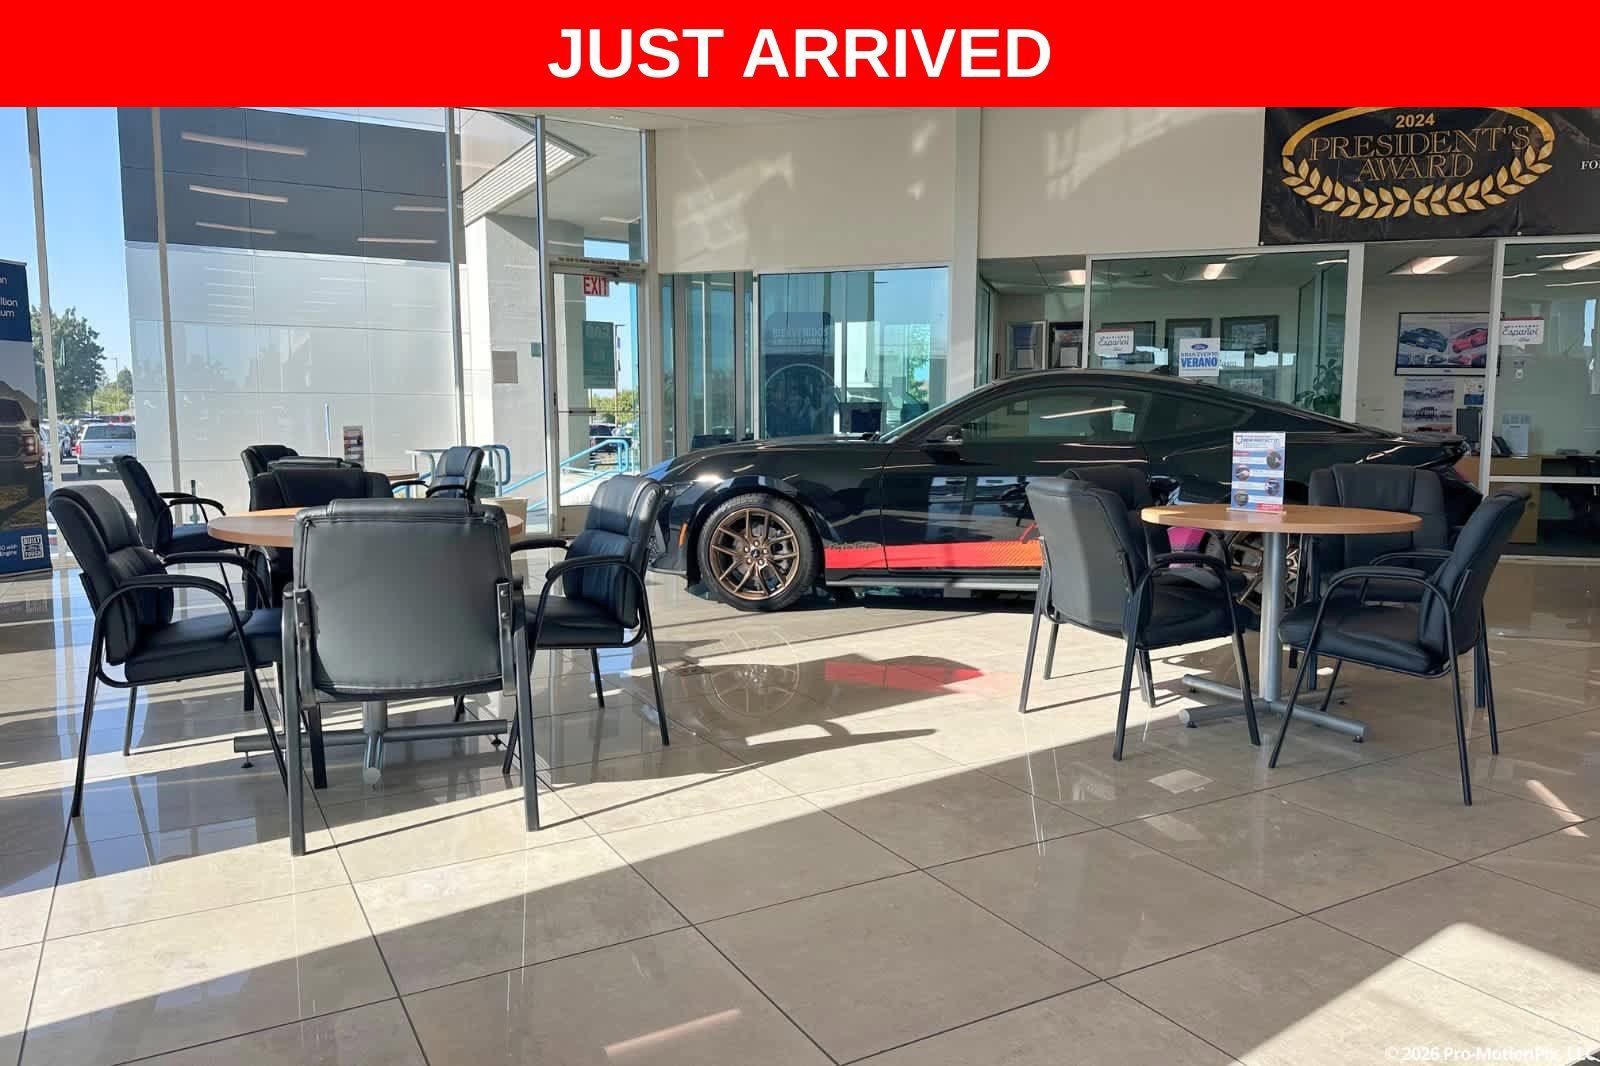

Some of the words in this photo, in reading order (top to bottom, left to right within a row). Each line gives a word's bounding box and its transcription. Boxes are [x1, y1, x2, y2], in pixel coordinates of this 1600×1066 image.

[1395, 112, 1436, 128] 2024
[1309, 125, 1530, 161] PRESIDENT'S
[1356, 153, 1474, 183] AWARD
[1580, 160, 1600, 170] FO
[583, 275, 608, 296] EXIT
[1181, 357, 1218, 368] VERANO
